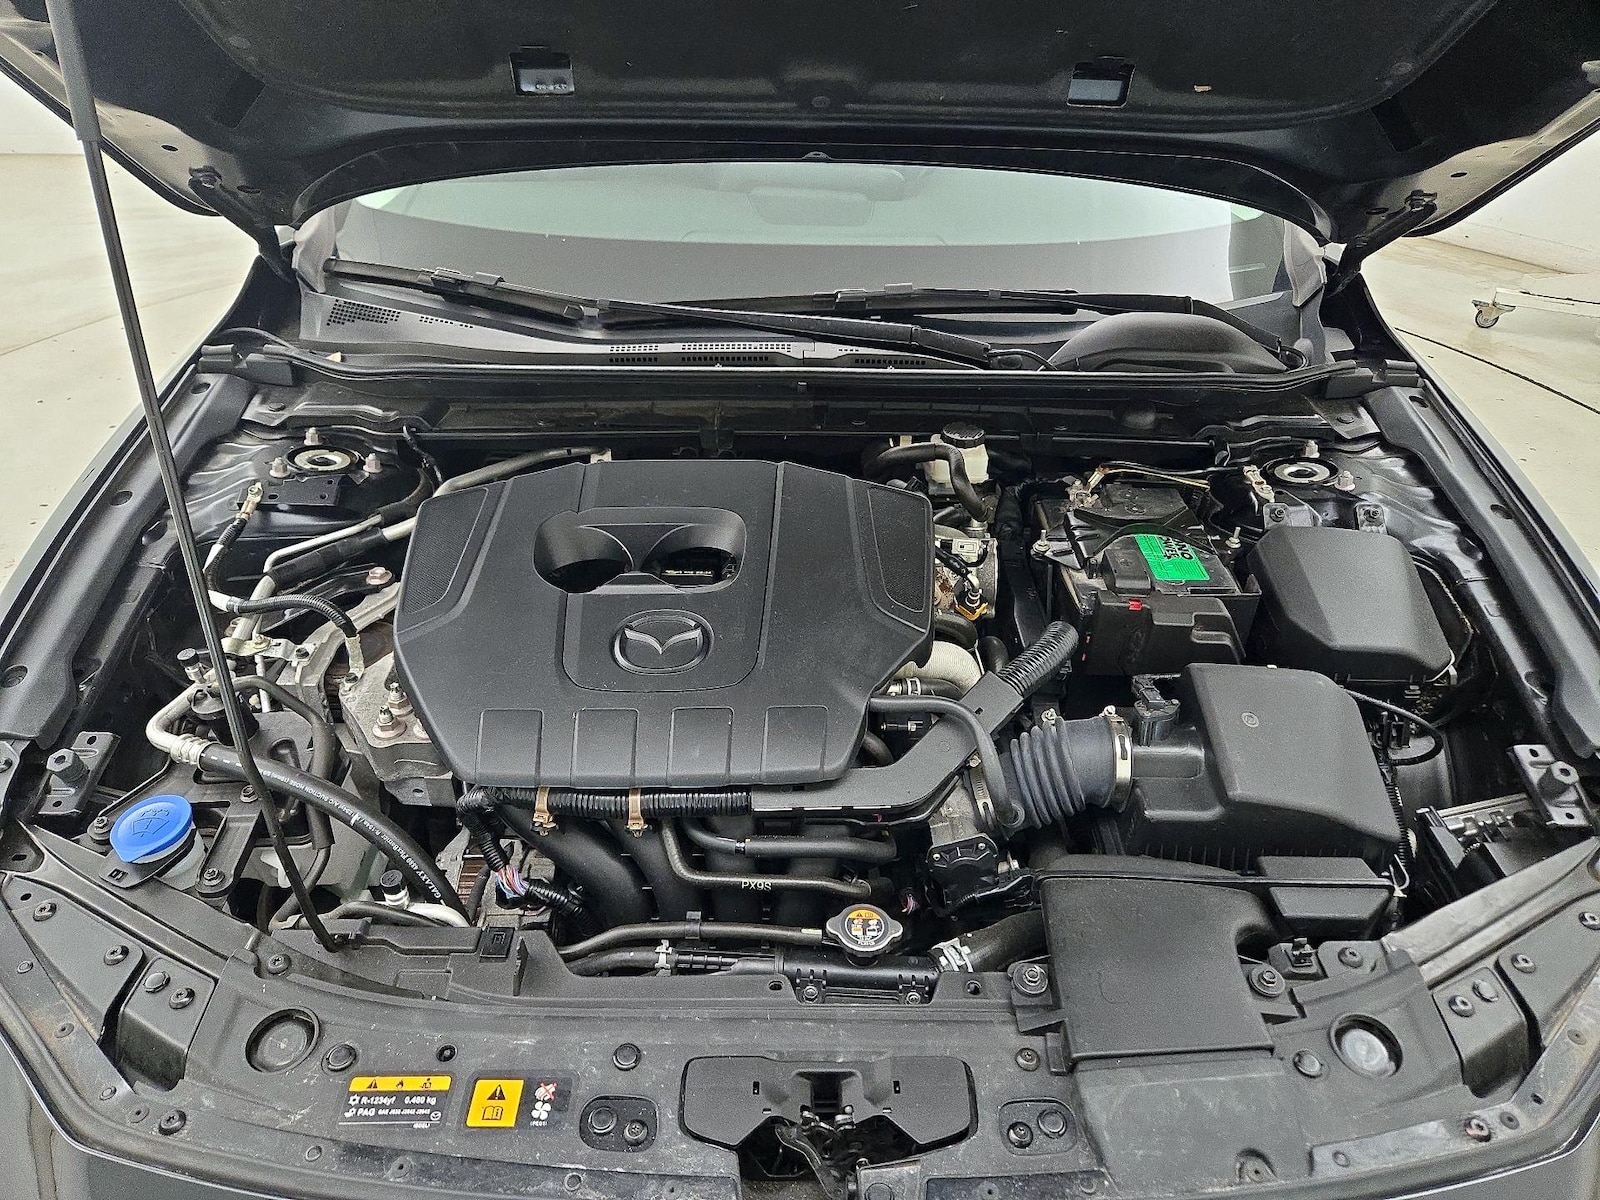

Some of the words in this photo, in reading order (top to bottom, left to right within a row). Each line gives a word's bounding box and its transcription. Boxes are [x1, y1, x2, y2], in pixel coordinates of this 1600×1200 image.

[289, 779, 305, 790] HOSE
[304, 786, 329, 801] SUCTION
[416, 870, 441, 898] GALAXY
[361, 1096, 397, 1106] R-1234yf
[426, 1096, 437, 1106] kg
[357, 1108, 376, 1117] PAG
